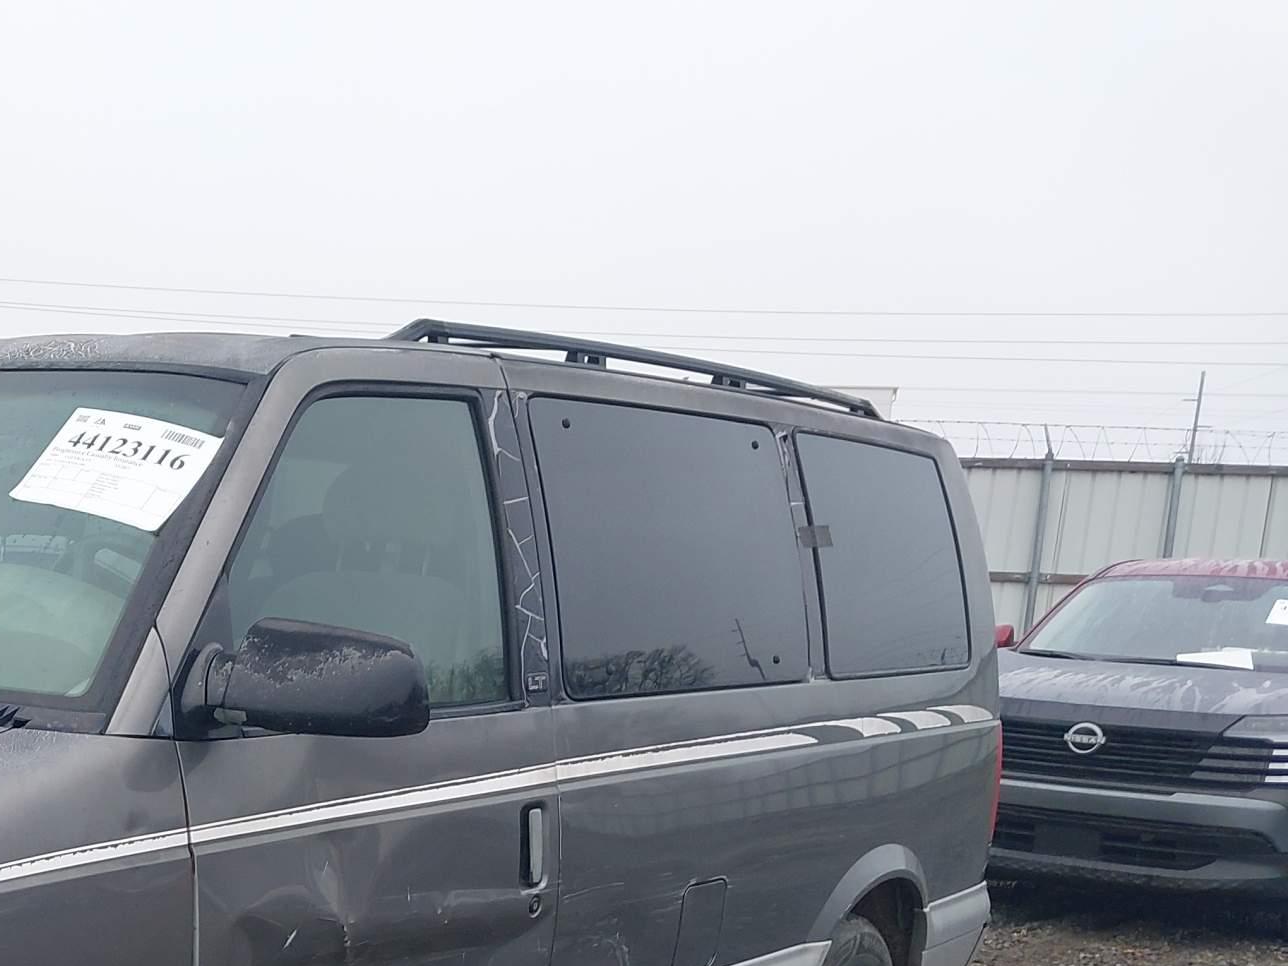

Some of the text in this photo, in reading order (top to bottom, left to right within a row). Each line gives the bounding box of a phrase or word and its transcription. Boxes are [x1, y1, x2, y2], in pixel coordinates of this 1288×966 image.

[67, 431, 191, 471] 44123116
[527, 675, 546, 691] LT
[1063, 733, 1106, 745] NISSAN
